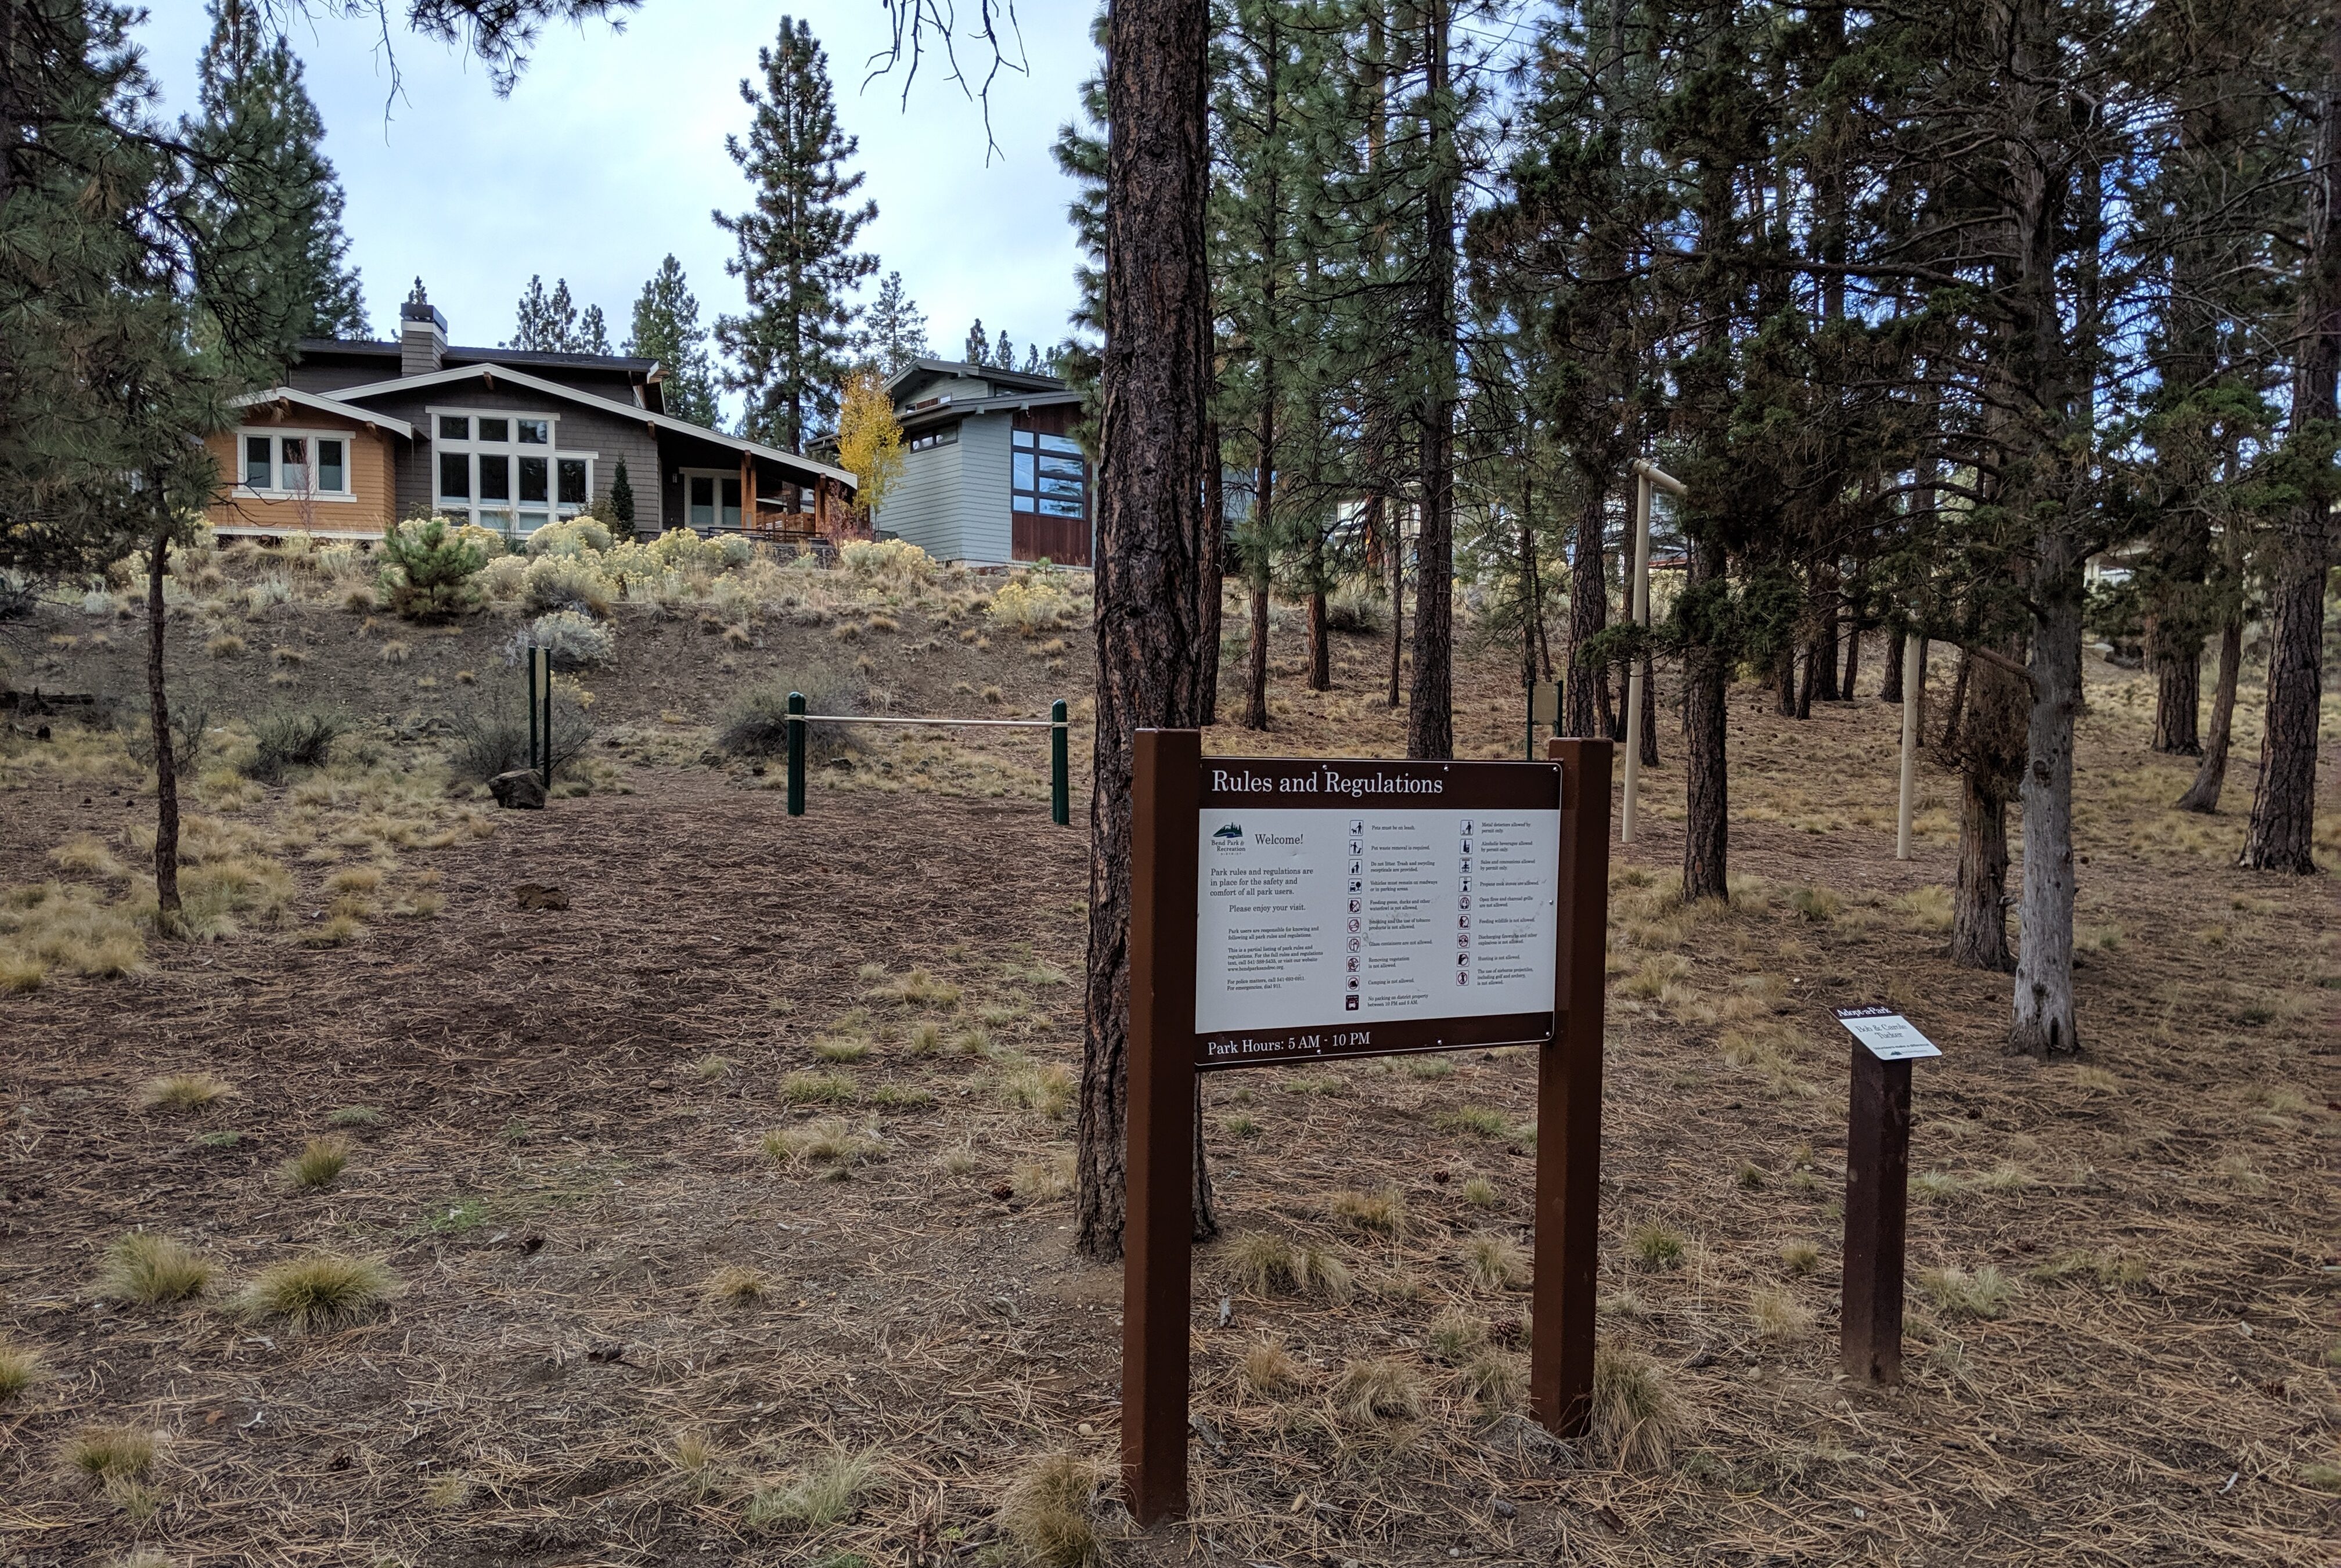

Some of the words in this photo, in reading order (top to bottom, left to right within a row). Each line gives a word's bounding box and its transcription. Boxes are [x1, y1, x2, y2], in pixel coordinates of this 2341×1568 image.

[1212, 770, 1272, 792] Rules
[1280, 772, 1318, 792] and
[1325, 772, 1443, 797] Regulations
[1255, 834, 1303, 844] Welcome!
[1263, 867, 1301, 876] regulations
[1219, 879, 1237, 887] place
[1263, 878, 1283, 886] safety
[1257, 888, 1272, 896] park
[1253, 904, 1271, 913] enjoy
[1208, 1041, 1238, 1055] Park
[1242, 1040, 1283, 1052] Hours:
[1288, 1037, 1295, 1050] 5
[1298, 1035, 1320, 1048] AM
[1333, 1034, 1346, 1046] 10
[1350, 1032, 1370, 1045] PM
